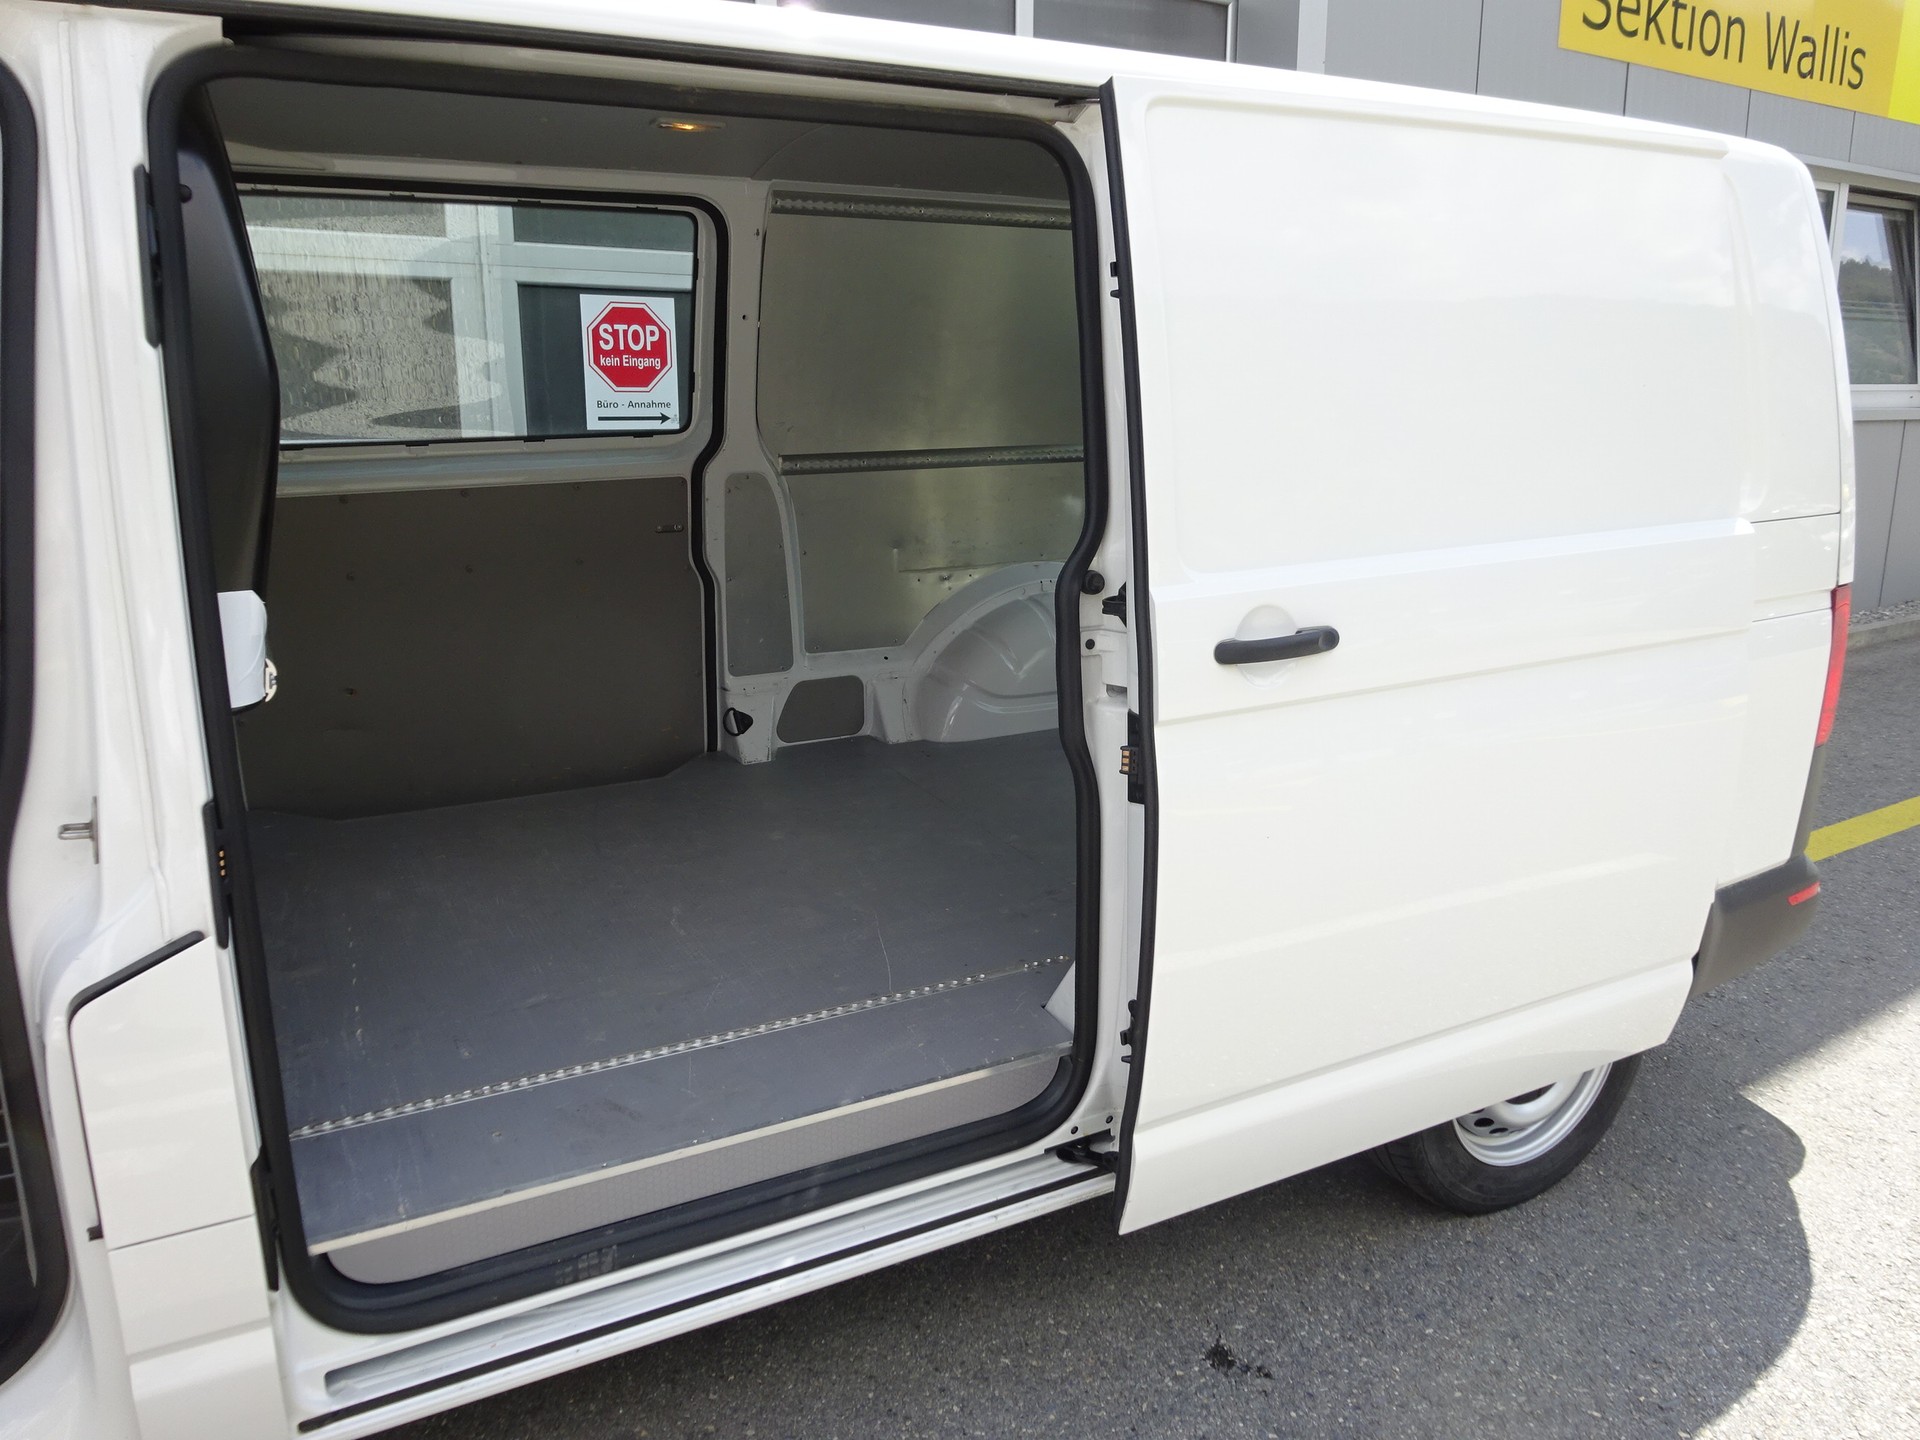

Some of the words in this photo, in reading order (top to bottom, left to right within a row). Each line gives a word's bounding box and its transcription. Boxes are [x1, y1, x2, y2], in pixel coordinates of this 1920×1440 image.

[1766, 12, 1867, 89] Wallis
[599, 324, 660, 351] STOP
[600, 355, 620, 367] kein
[622, 355, 661, 370] Eingang
[597, 400, 619, 409] Büro
[627, 400, 671, 409] Annahme
